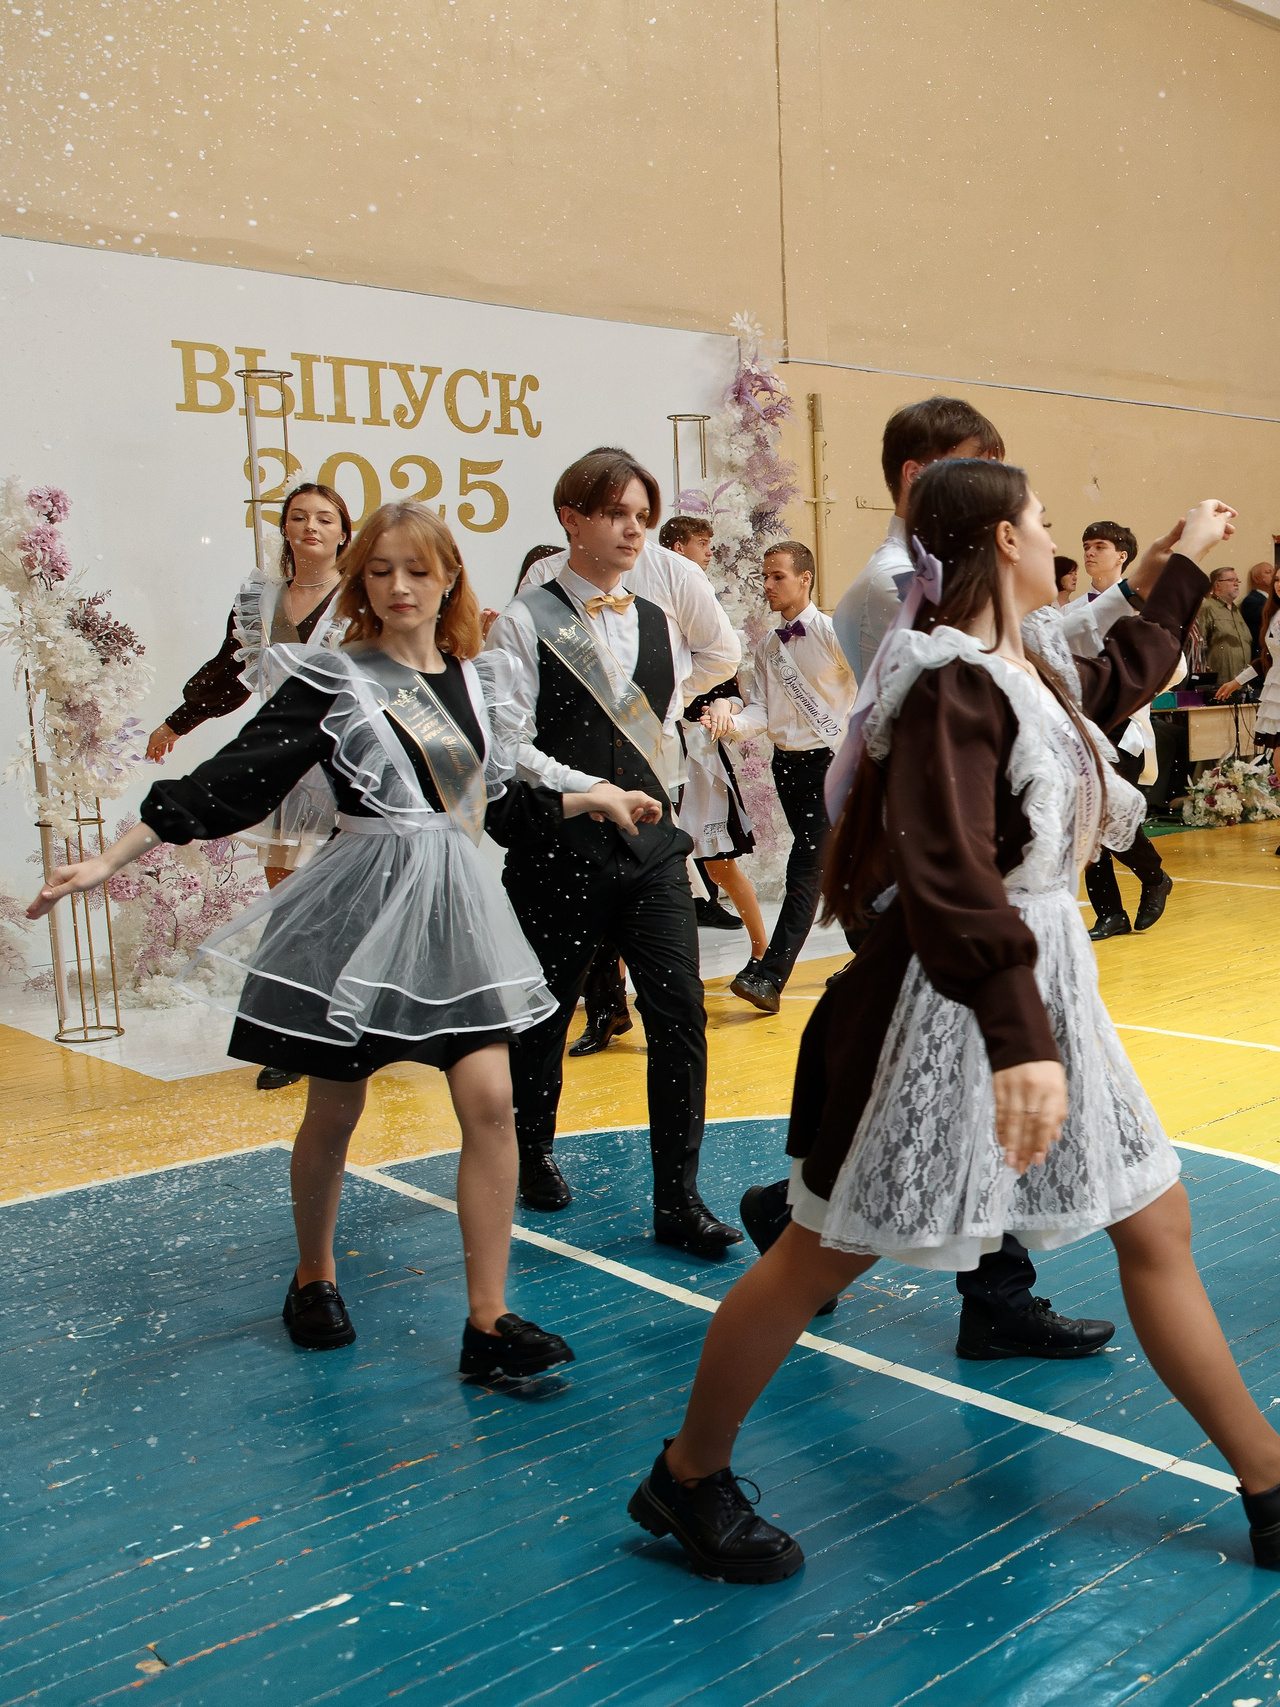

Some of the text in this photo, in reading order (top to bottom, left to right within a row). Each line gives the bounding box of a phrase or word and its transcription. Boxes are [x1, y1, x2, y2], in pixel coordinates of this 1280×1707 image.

[171, 339, 542, 439] ВЫПУСК
[243, 447, 510, 534] 2025
[780, 665, 821, 718] Выпускник
[815, 713, 842, 737] 2025
